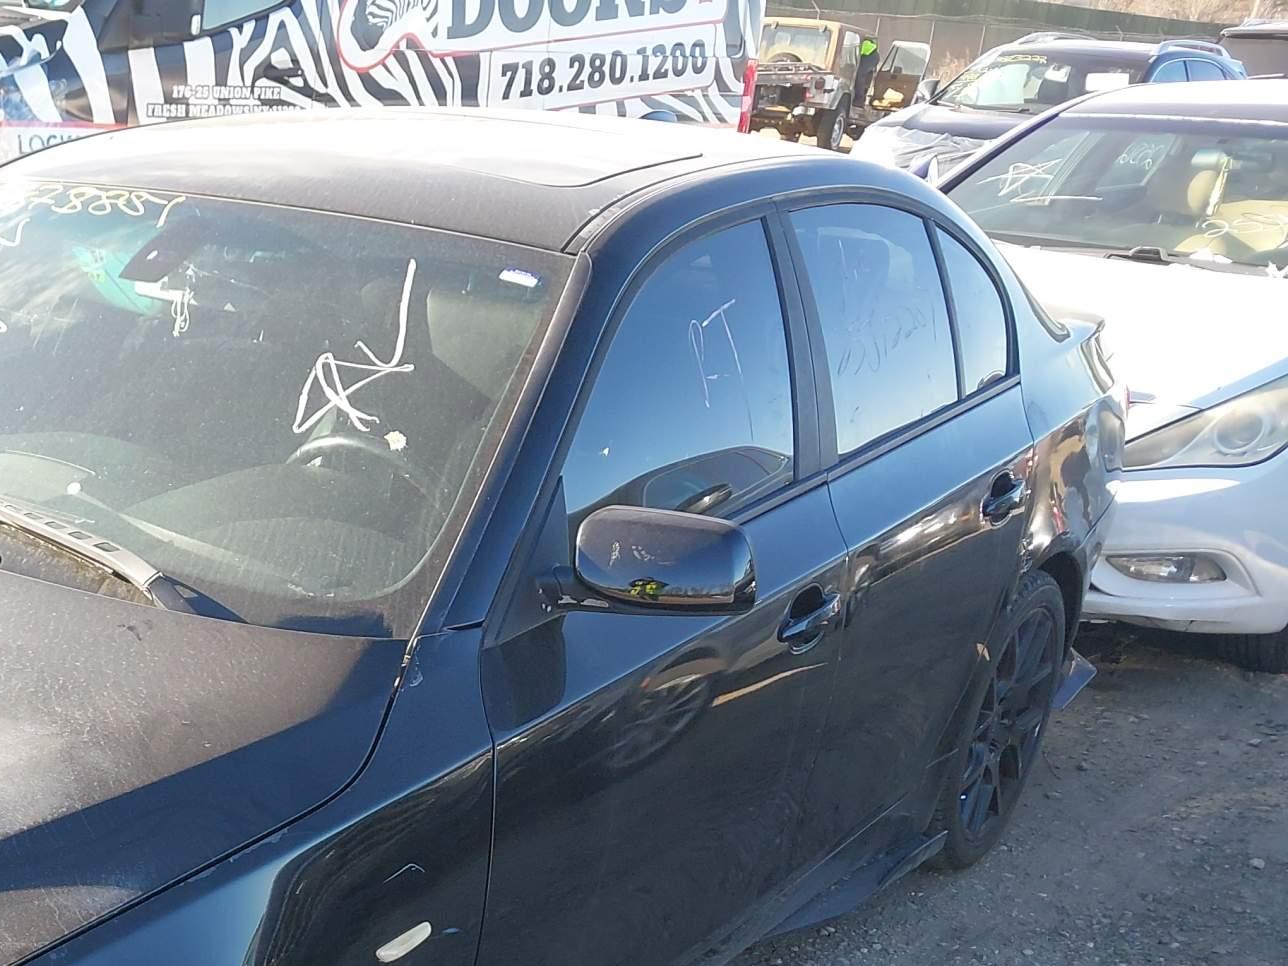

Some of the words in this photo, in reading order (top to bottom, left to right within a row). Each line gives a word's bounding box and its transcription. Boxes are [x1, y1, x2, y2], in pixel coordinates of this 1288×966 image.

[447, 0, 688, 39] DOO
[500, 39, 706, 101] 718.280.1200
[172, 86, 209, 99] 176-25
[213, 86, 250, 99] UNION
[253, 86, 281, 99] PIKE
[147, 104, 186, 117] FRESH
[188, 104, 250, 117] MEADOWS
[17, 134, 82, 155] LOC
